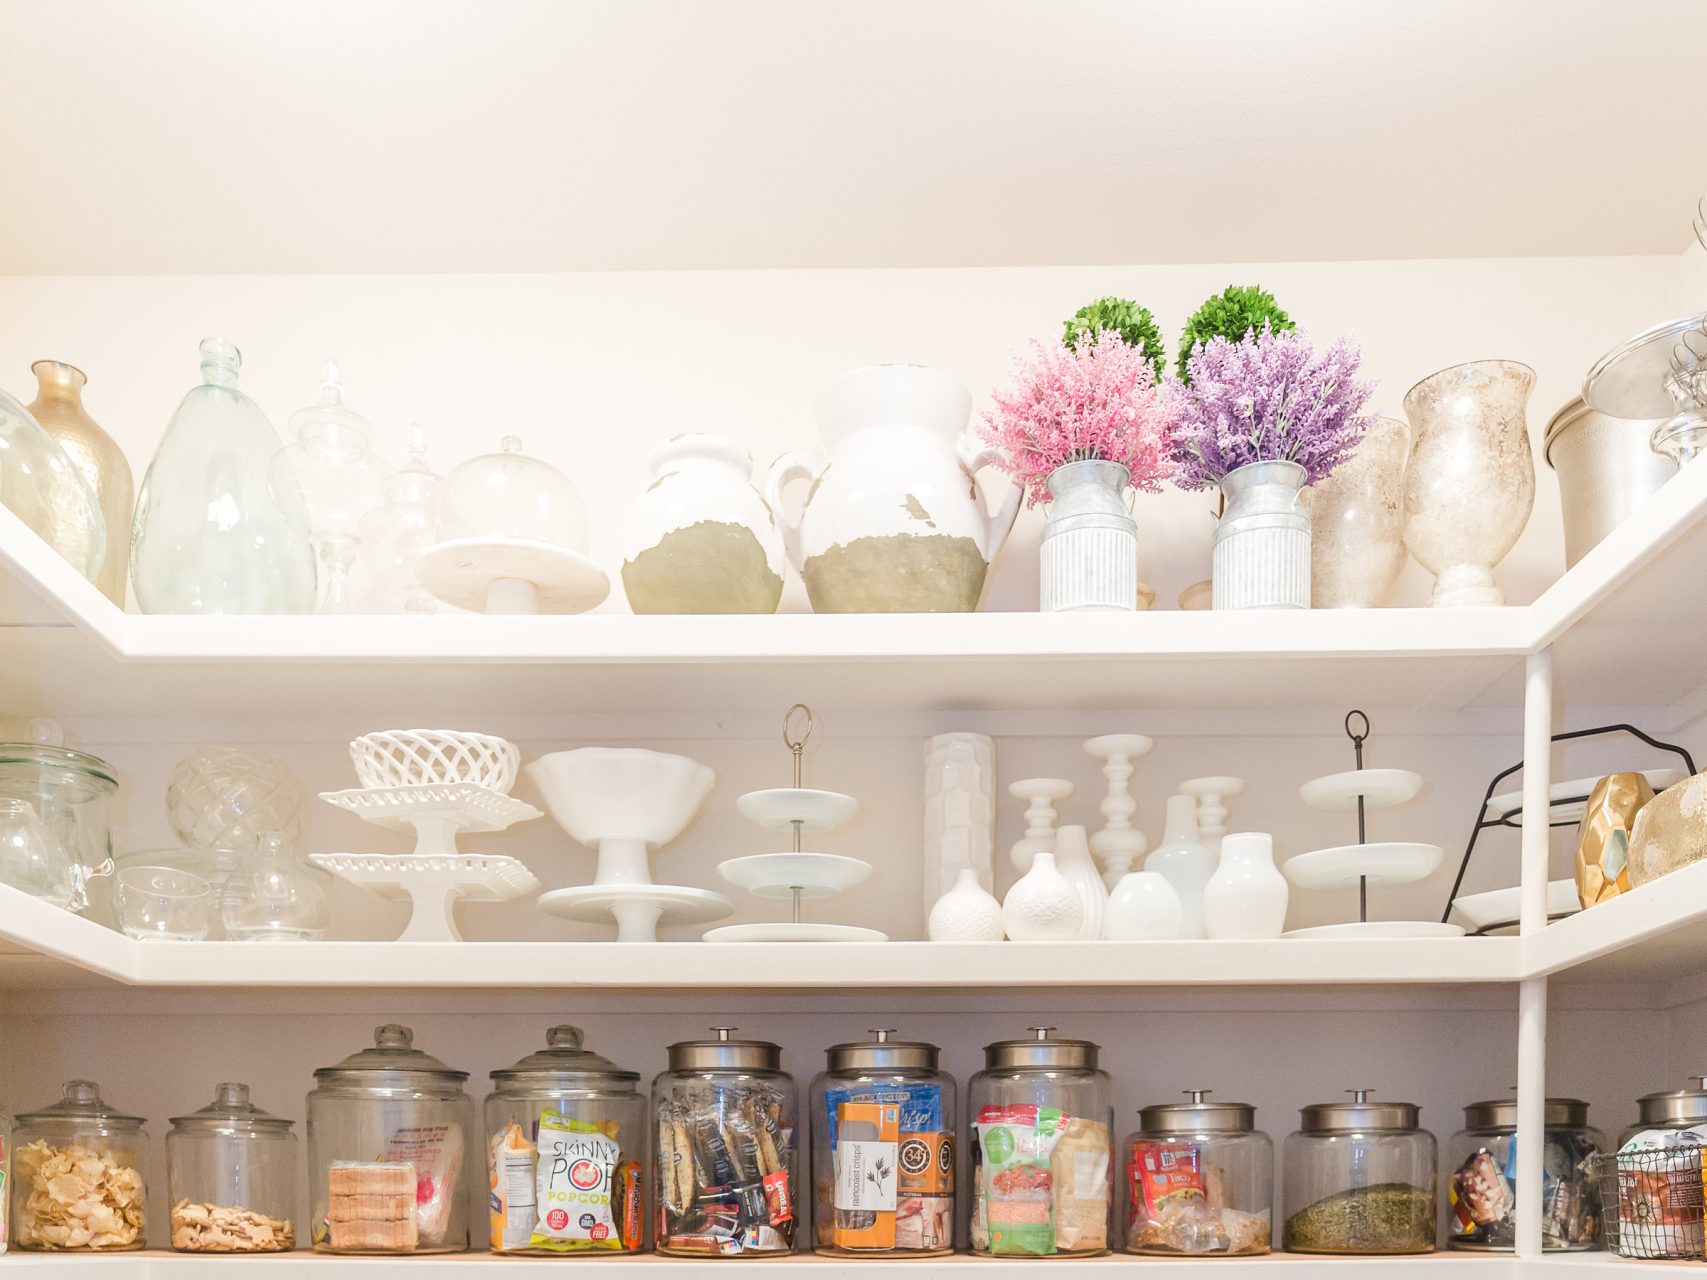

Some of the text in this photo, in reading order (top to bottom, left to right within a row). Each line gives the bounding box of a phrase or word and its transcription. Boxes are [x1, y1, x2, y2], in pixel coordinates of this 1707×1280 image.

[852, 1144, 862, 1207] raincoast crisps
[547, 1191, 610, 1205] POPCOR
[633, 1177, 642, 1213] Maruchan
[775, 1181, 788, 1215] UNREAL
